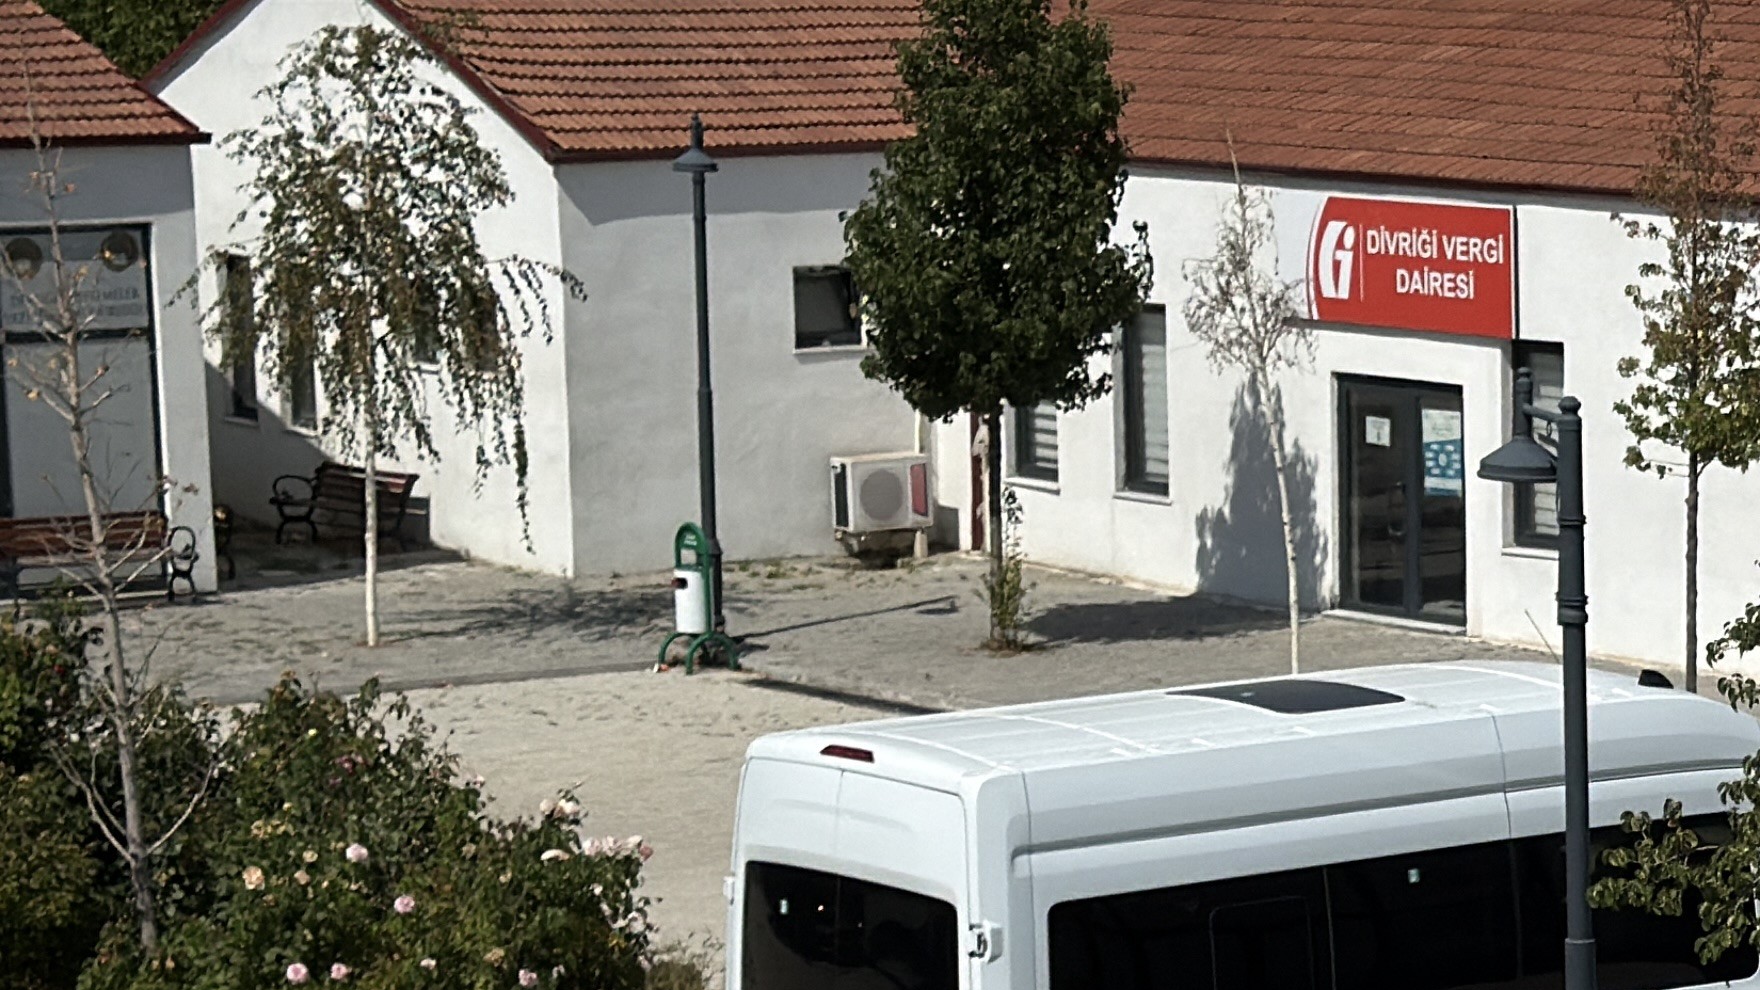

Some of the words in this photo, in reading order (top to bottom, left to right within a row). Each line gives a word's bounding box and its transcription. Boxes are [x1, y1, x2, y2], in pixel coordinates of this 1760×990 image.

[1366, 225, 1438, 259] DİVRİĞİ
[1442, 234, 1504, 265] VERGİ
[1395, 266, 1474, 300] DAİRESİ
